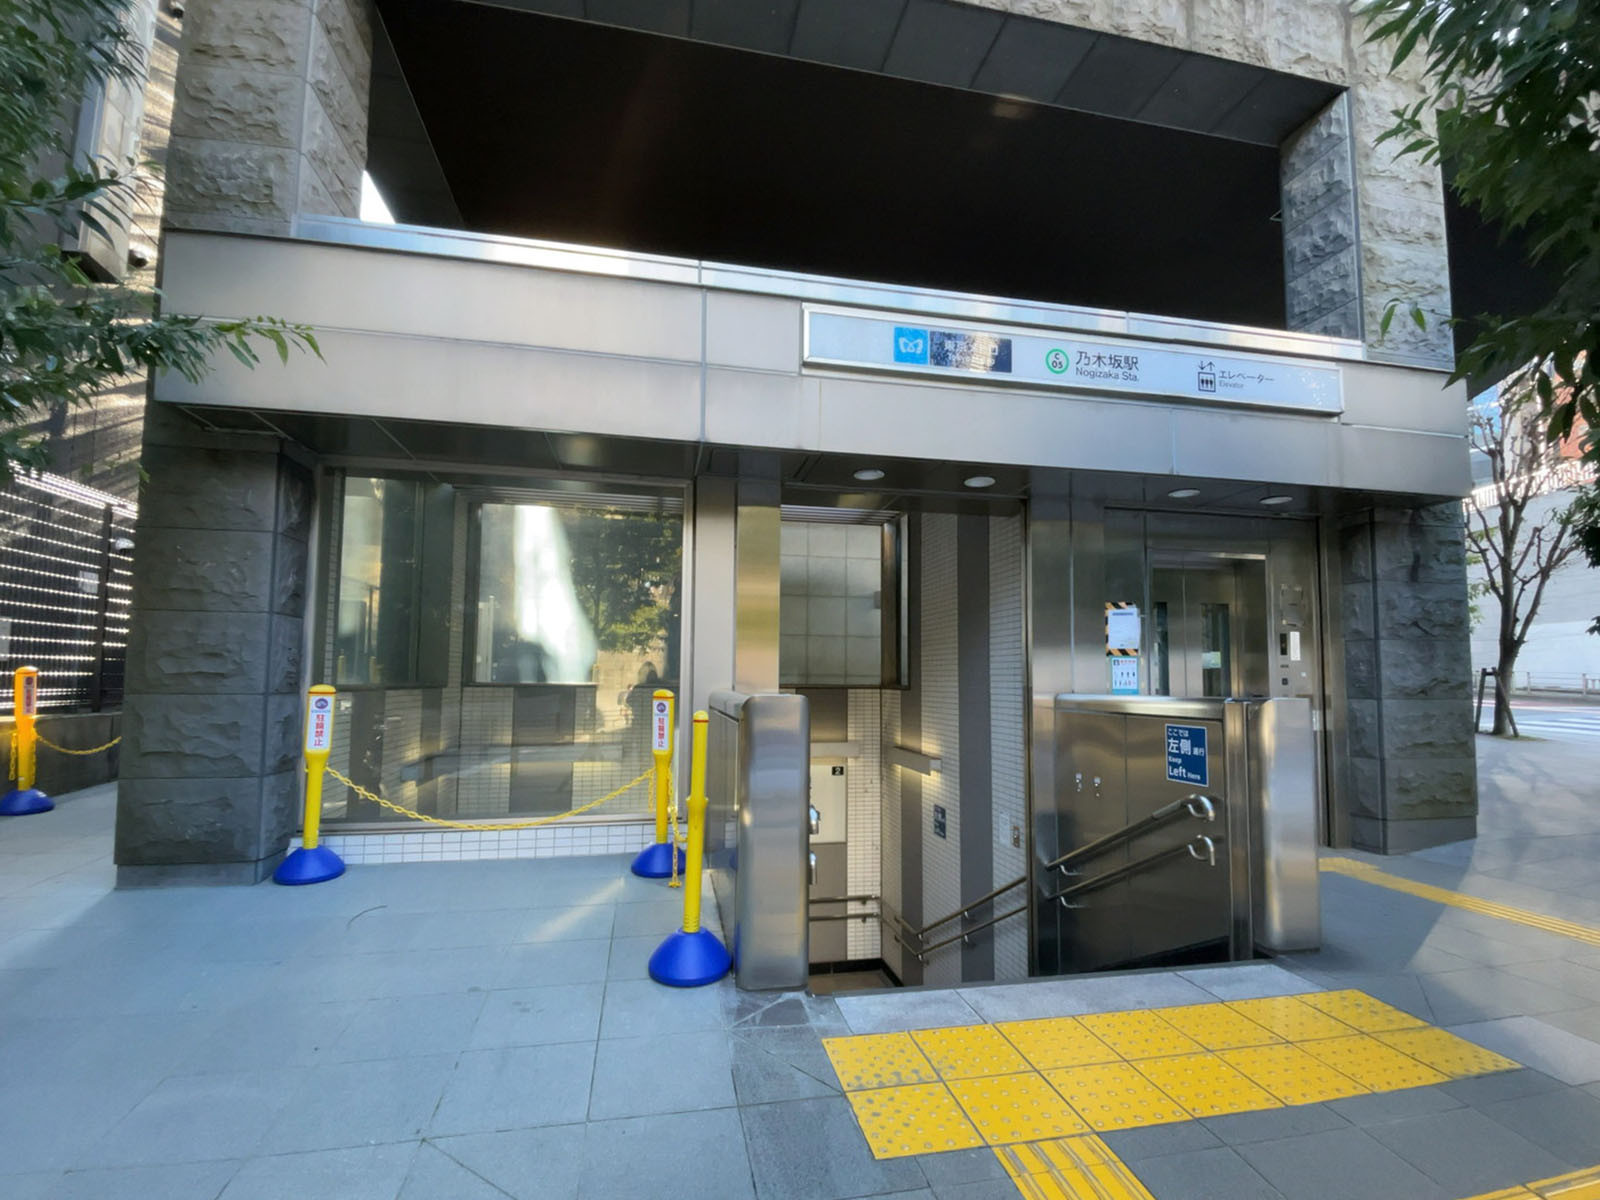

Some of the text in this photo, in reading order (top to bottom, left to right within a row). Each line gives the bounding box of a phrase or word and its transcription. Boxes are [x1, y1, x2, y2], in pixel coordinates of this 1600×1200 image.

[1051, 360, 1063, 369] 05
[1076, 350, 1139, 371] 乃木坂駅
[1076, 367, 1139, 382] Nogizaka Sta.
[1218, 370, 1275, 384] エレベーター
[1168, 728, 1189, 737] ここでは
[1168, 755, 1182, 764] Keep
[1169, 765, 1201, 780] Left Here
